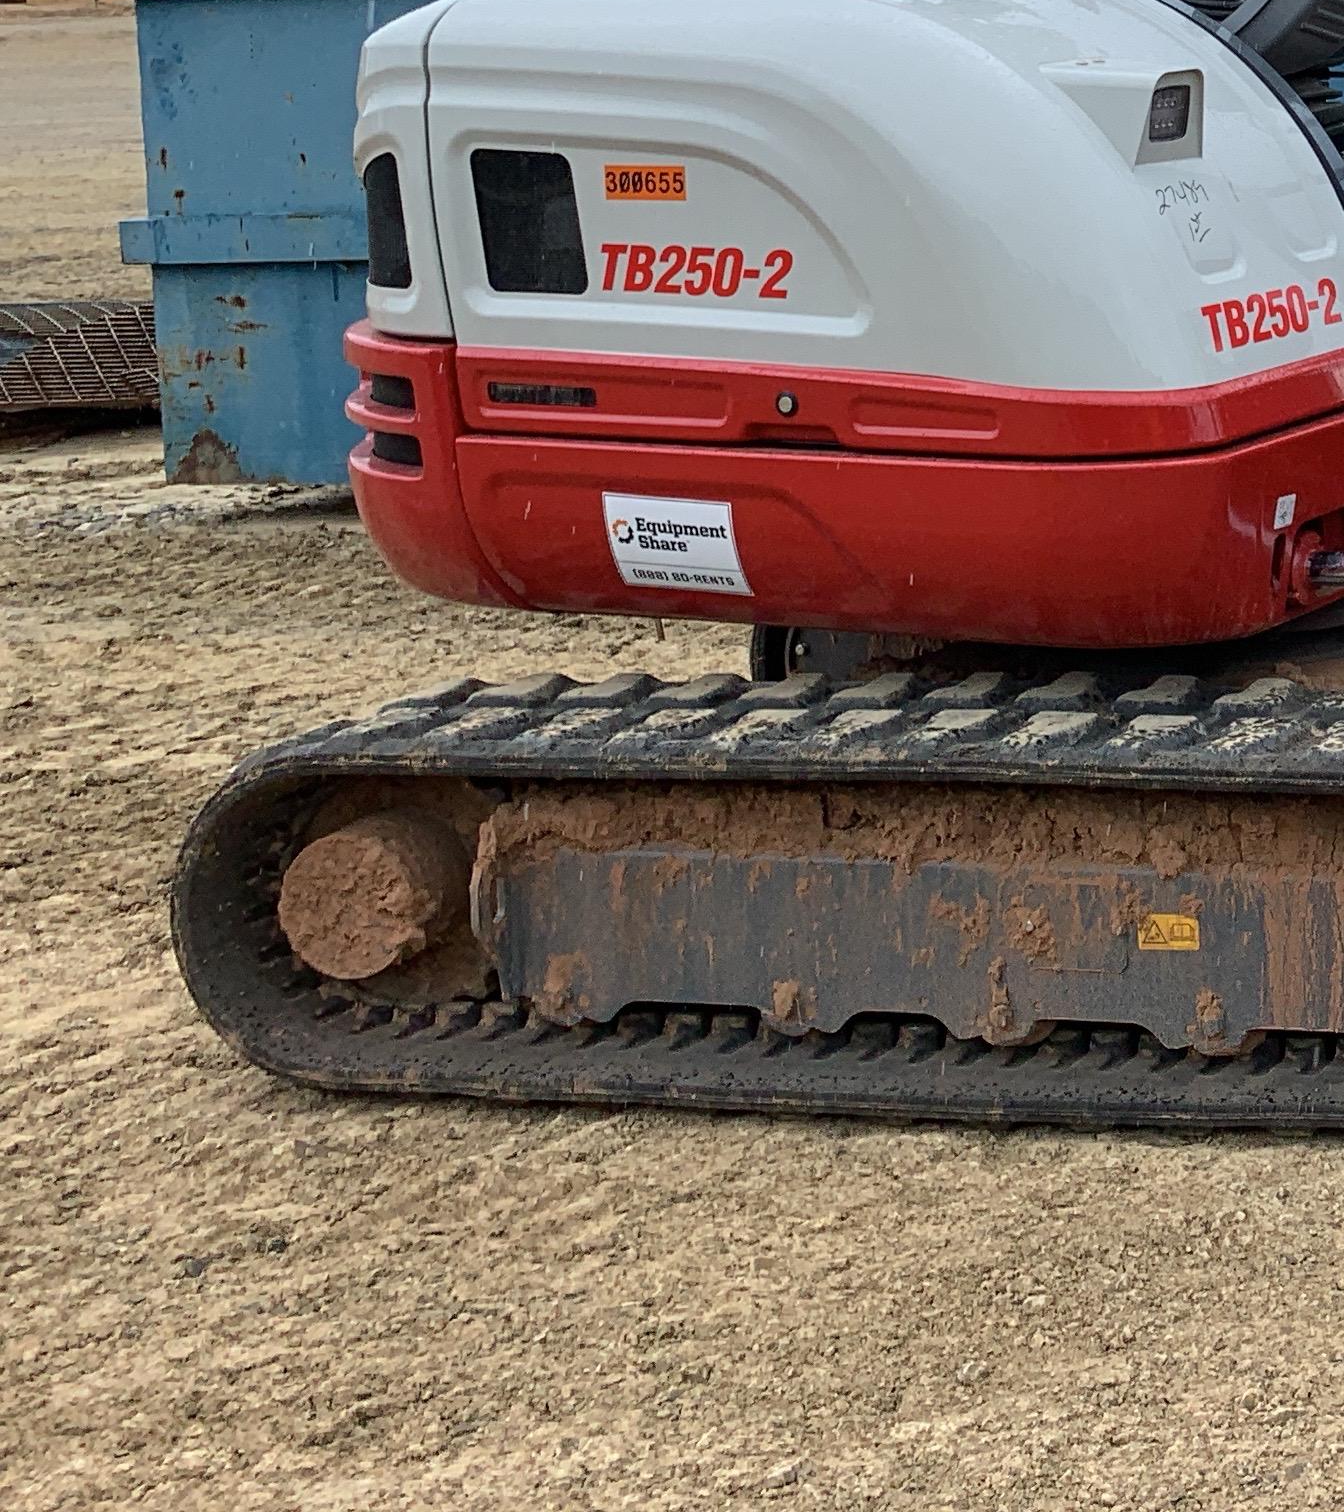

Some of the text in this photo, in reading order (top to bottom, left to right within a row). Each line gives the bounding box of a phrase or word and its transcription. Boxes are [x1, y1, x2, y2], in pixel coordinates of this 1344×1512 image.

[605, 171, 685, 194] 300655
[600, 243, 794, 299] TB250-2
[1200, 278, 1343, 354] TB250-2
[635, 517, 728, 539] Equipment
[639, 535, 688, 552] Share
